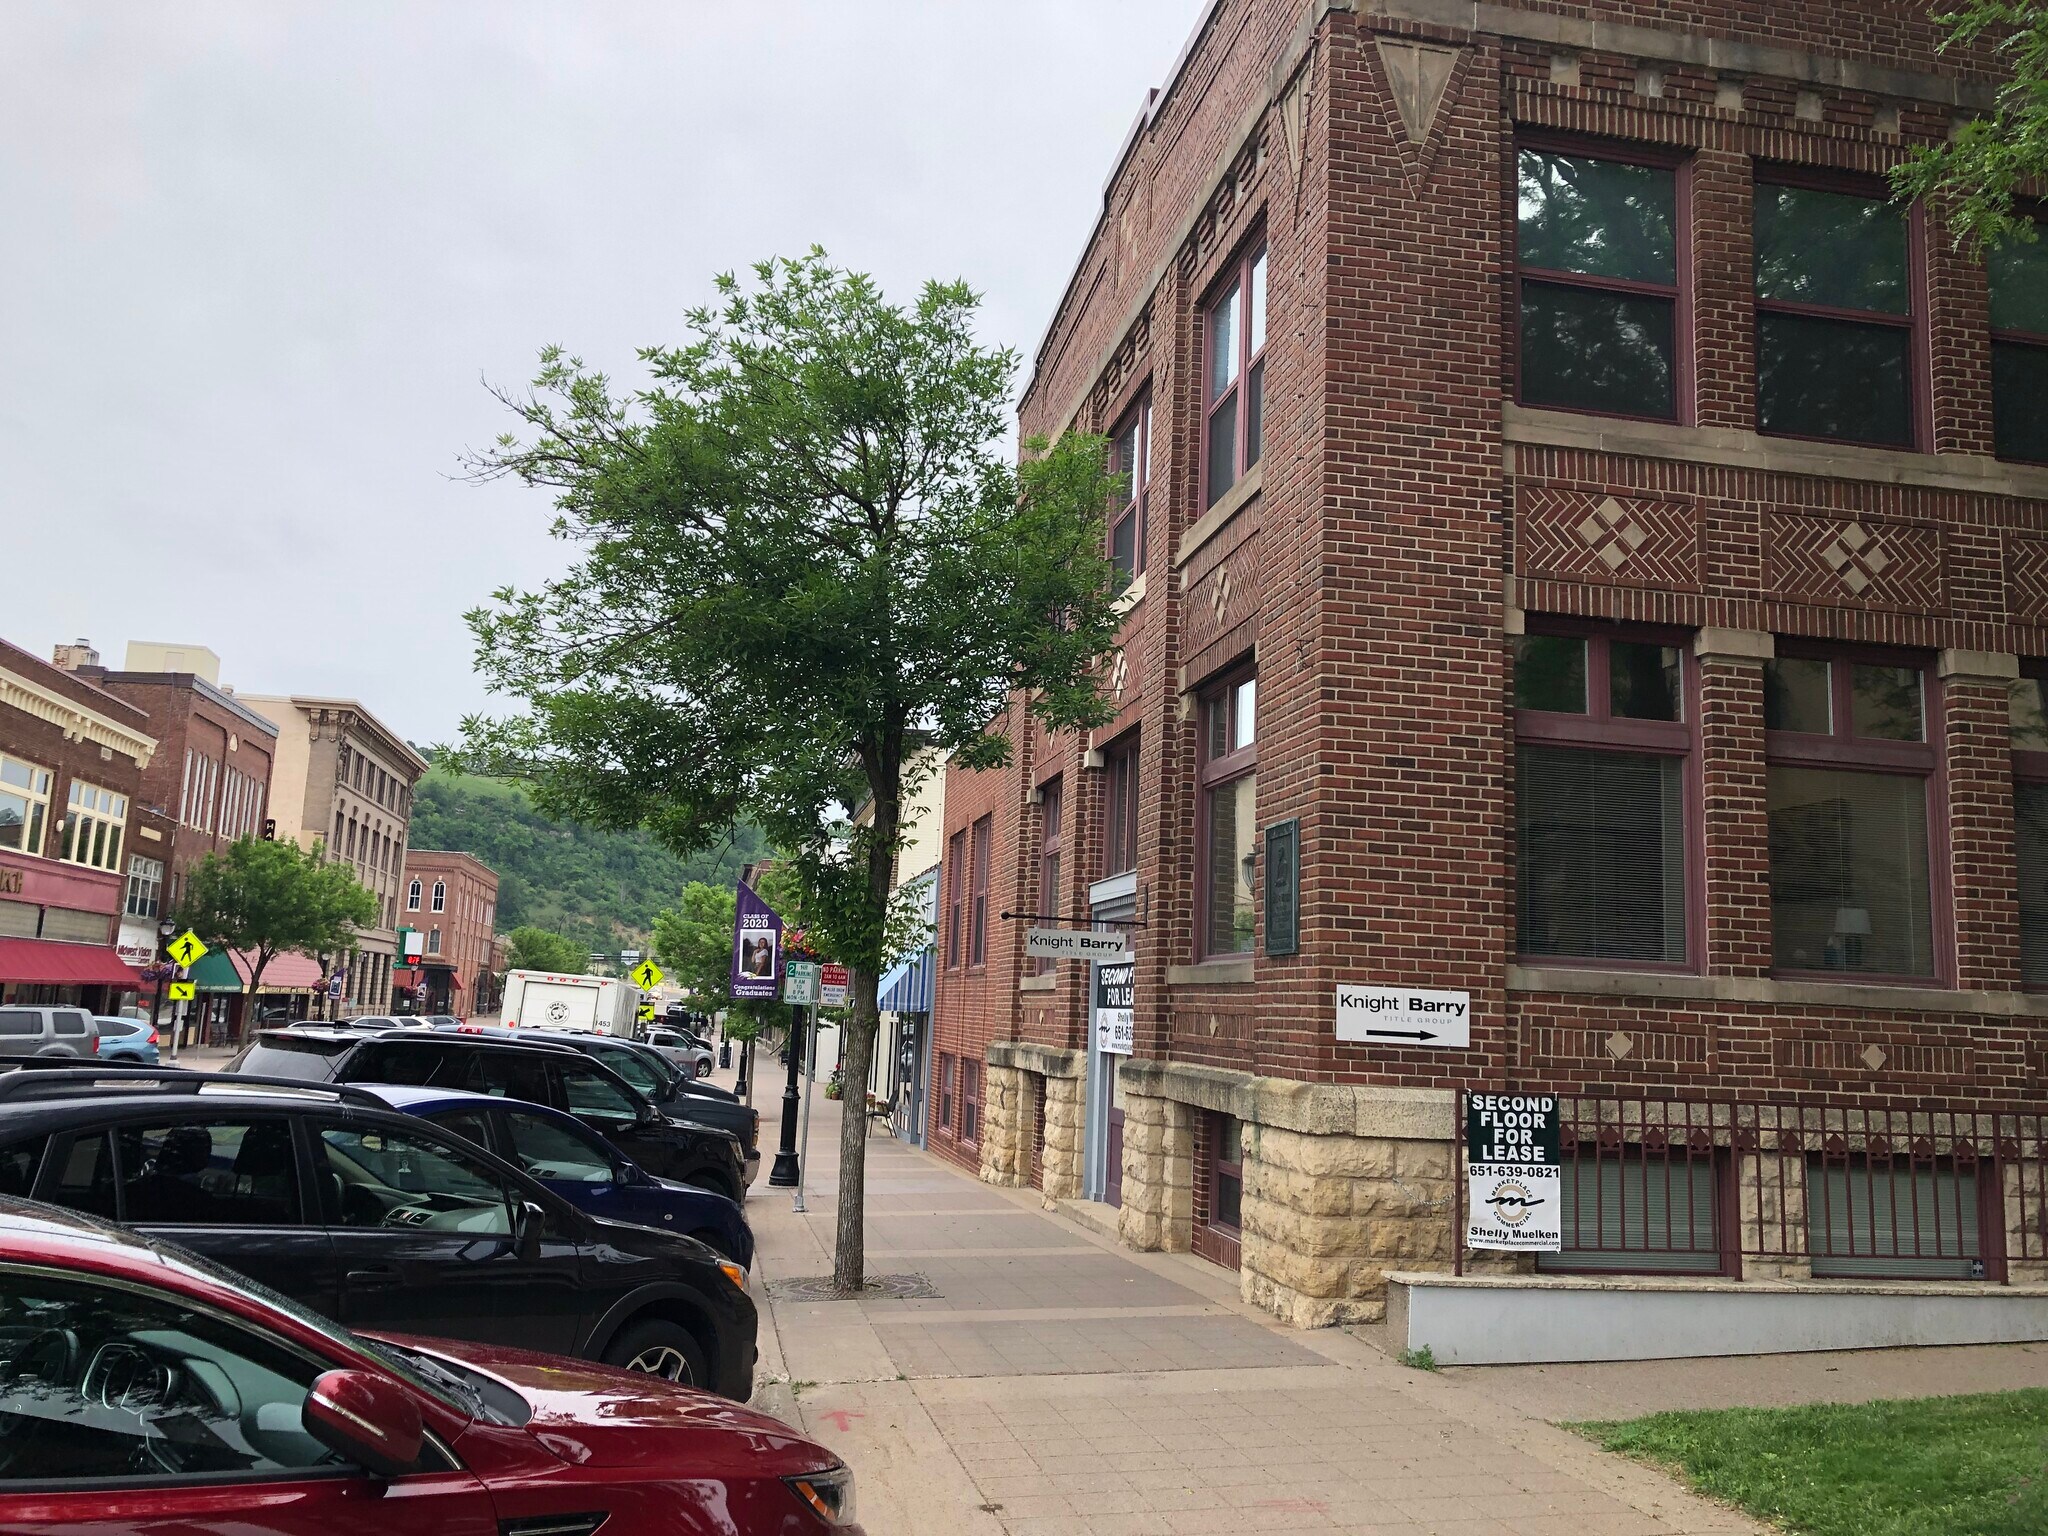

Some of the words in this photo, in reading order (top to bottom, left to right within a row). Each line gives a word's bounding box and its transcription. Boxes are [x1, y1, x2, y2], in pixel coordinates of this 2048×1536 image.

[743, 919, 769, 928] 2020
[117, 945, 138, 956] Midwest
[138, 947, 152, 957] Vision
[1030, 935, 1073, 949] Knight
[1080, 938, 1123, 952] Barry
[788, 964, 796, 976] 2
[1101, 968, 1128, 985] SECOND
[1107, 988, 1120, 1006] FOR
[1340, 994, 1399, 1013] Knight
[1409, 997, 1466, 1017] Barry
[1117, 1012, 1129, 1025] Shelly
[1384, 1015, 1412, 1023] TITLE
[1417, 1017, 1453, 1025] GROUP
[1472, 1095, 1554, 1112] SECOND
[1480, 1112, 1546, 1129] FLOOR
[1494, 1128, 1533, 1145] FOR
[1483, 1145, 1545, 1162] LEASE
[1470, 1165, 1559, 1179] 651-639-0821
[1491, 1179, 1533, 1200] MARKETPLACE
[1493, 1210, 1533, 1228] COMMERCIAL
[1471, 1226, 1509, 1240] Shelly
[1512, 1229, 1559, 1239] Muelken
[1468, 1237, 1560, 1247] www.marketplacecommercial.com
